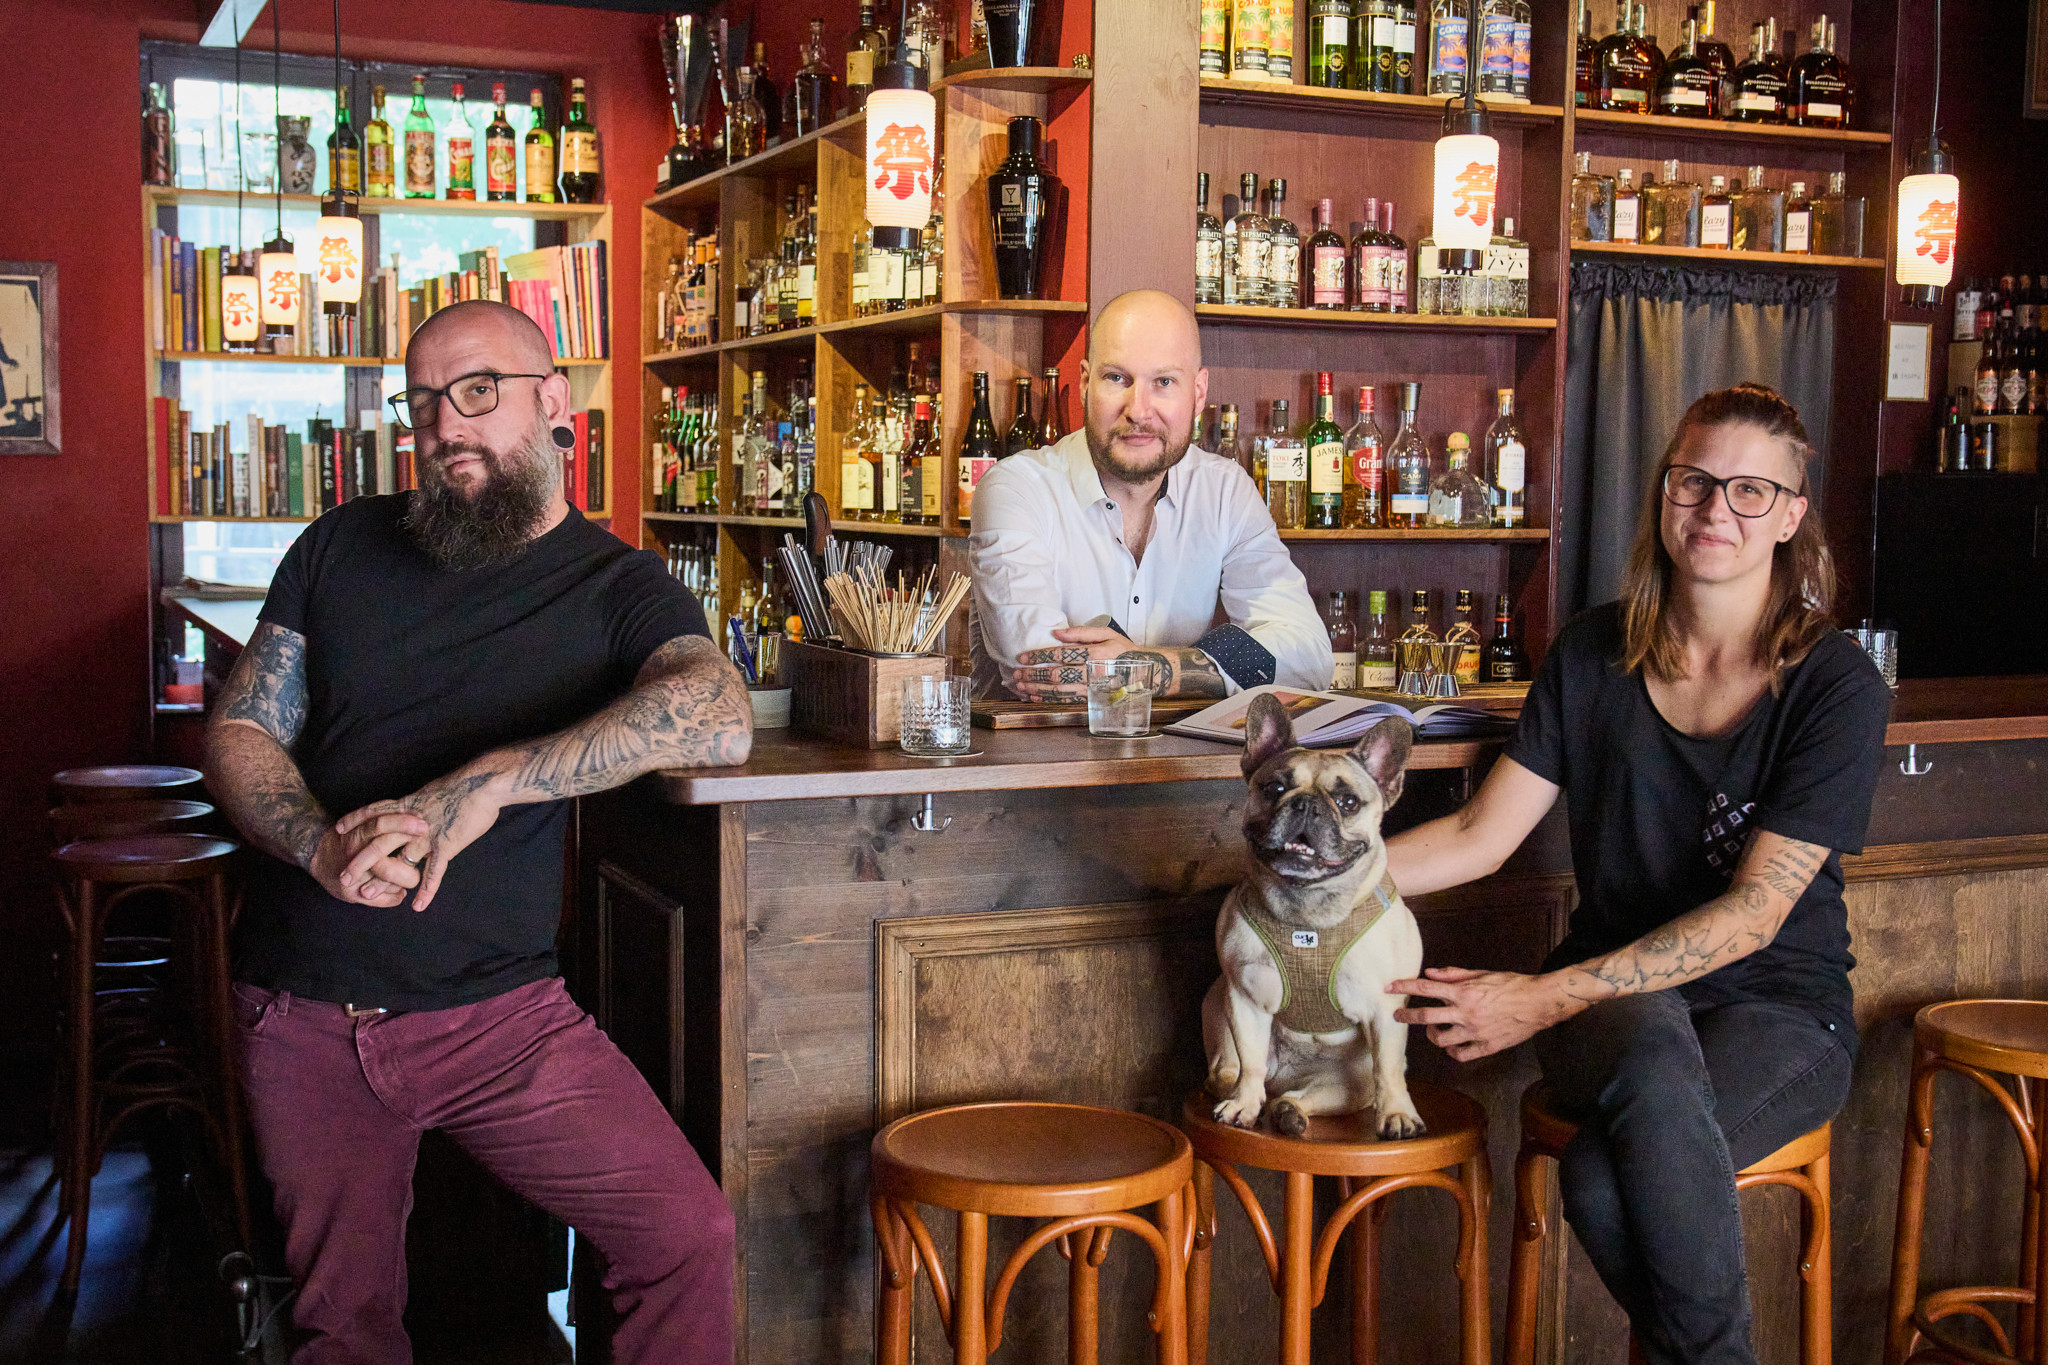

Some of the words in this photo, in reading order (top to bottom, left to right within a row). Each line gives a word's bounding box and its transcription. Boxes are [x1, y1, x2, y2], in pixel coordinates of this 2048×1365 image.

[1319, 4, 1335, 12] TIO
[873, 122, 933, 200] 祭
[1452, 160, 1498, 227] 祭
[1914, 199, 1958, 265] 祭
[319, 236, 358, 283] 祭
[226, 292, 255, 327] 祭
[268, 270, 301, 311] 祭
